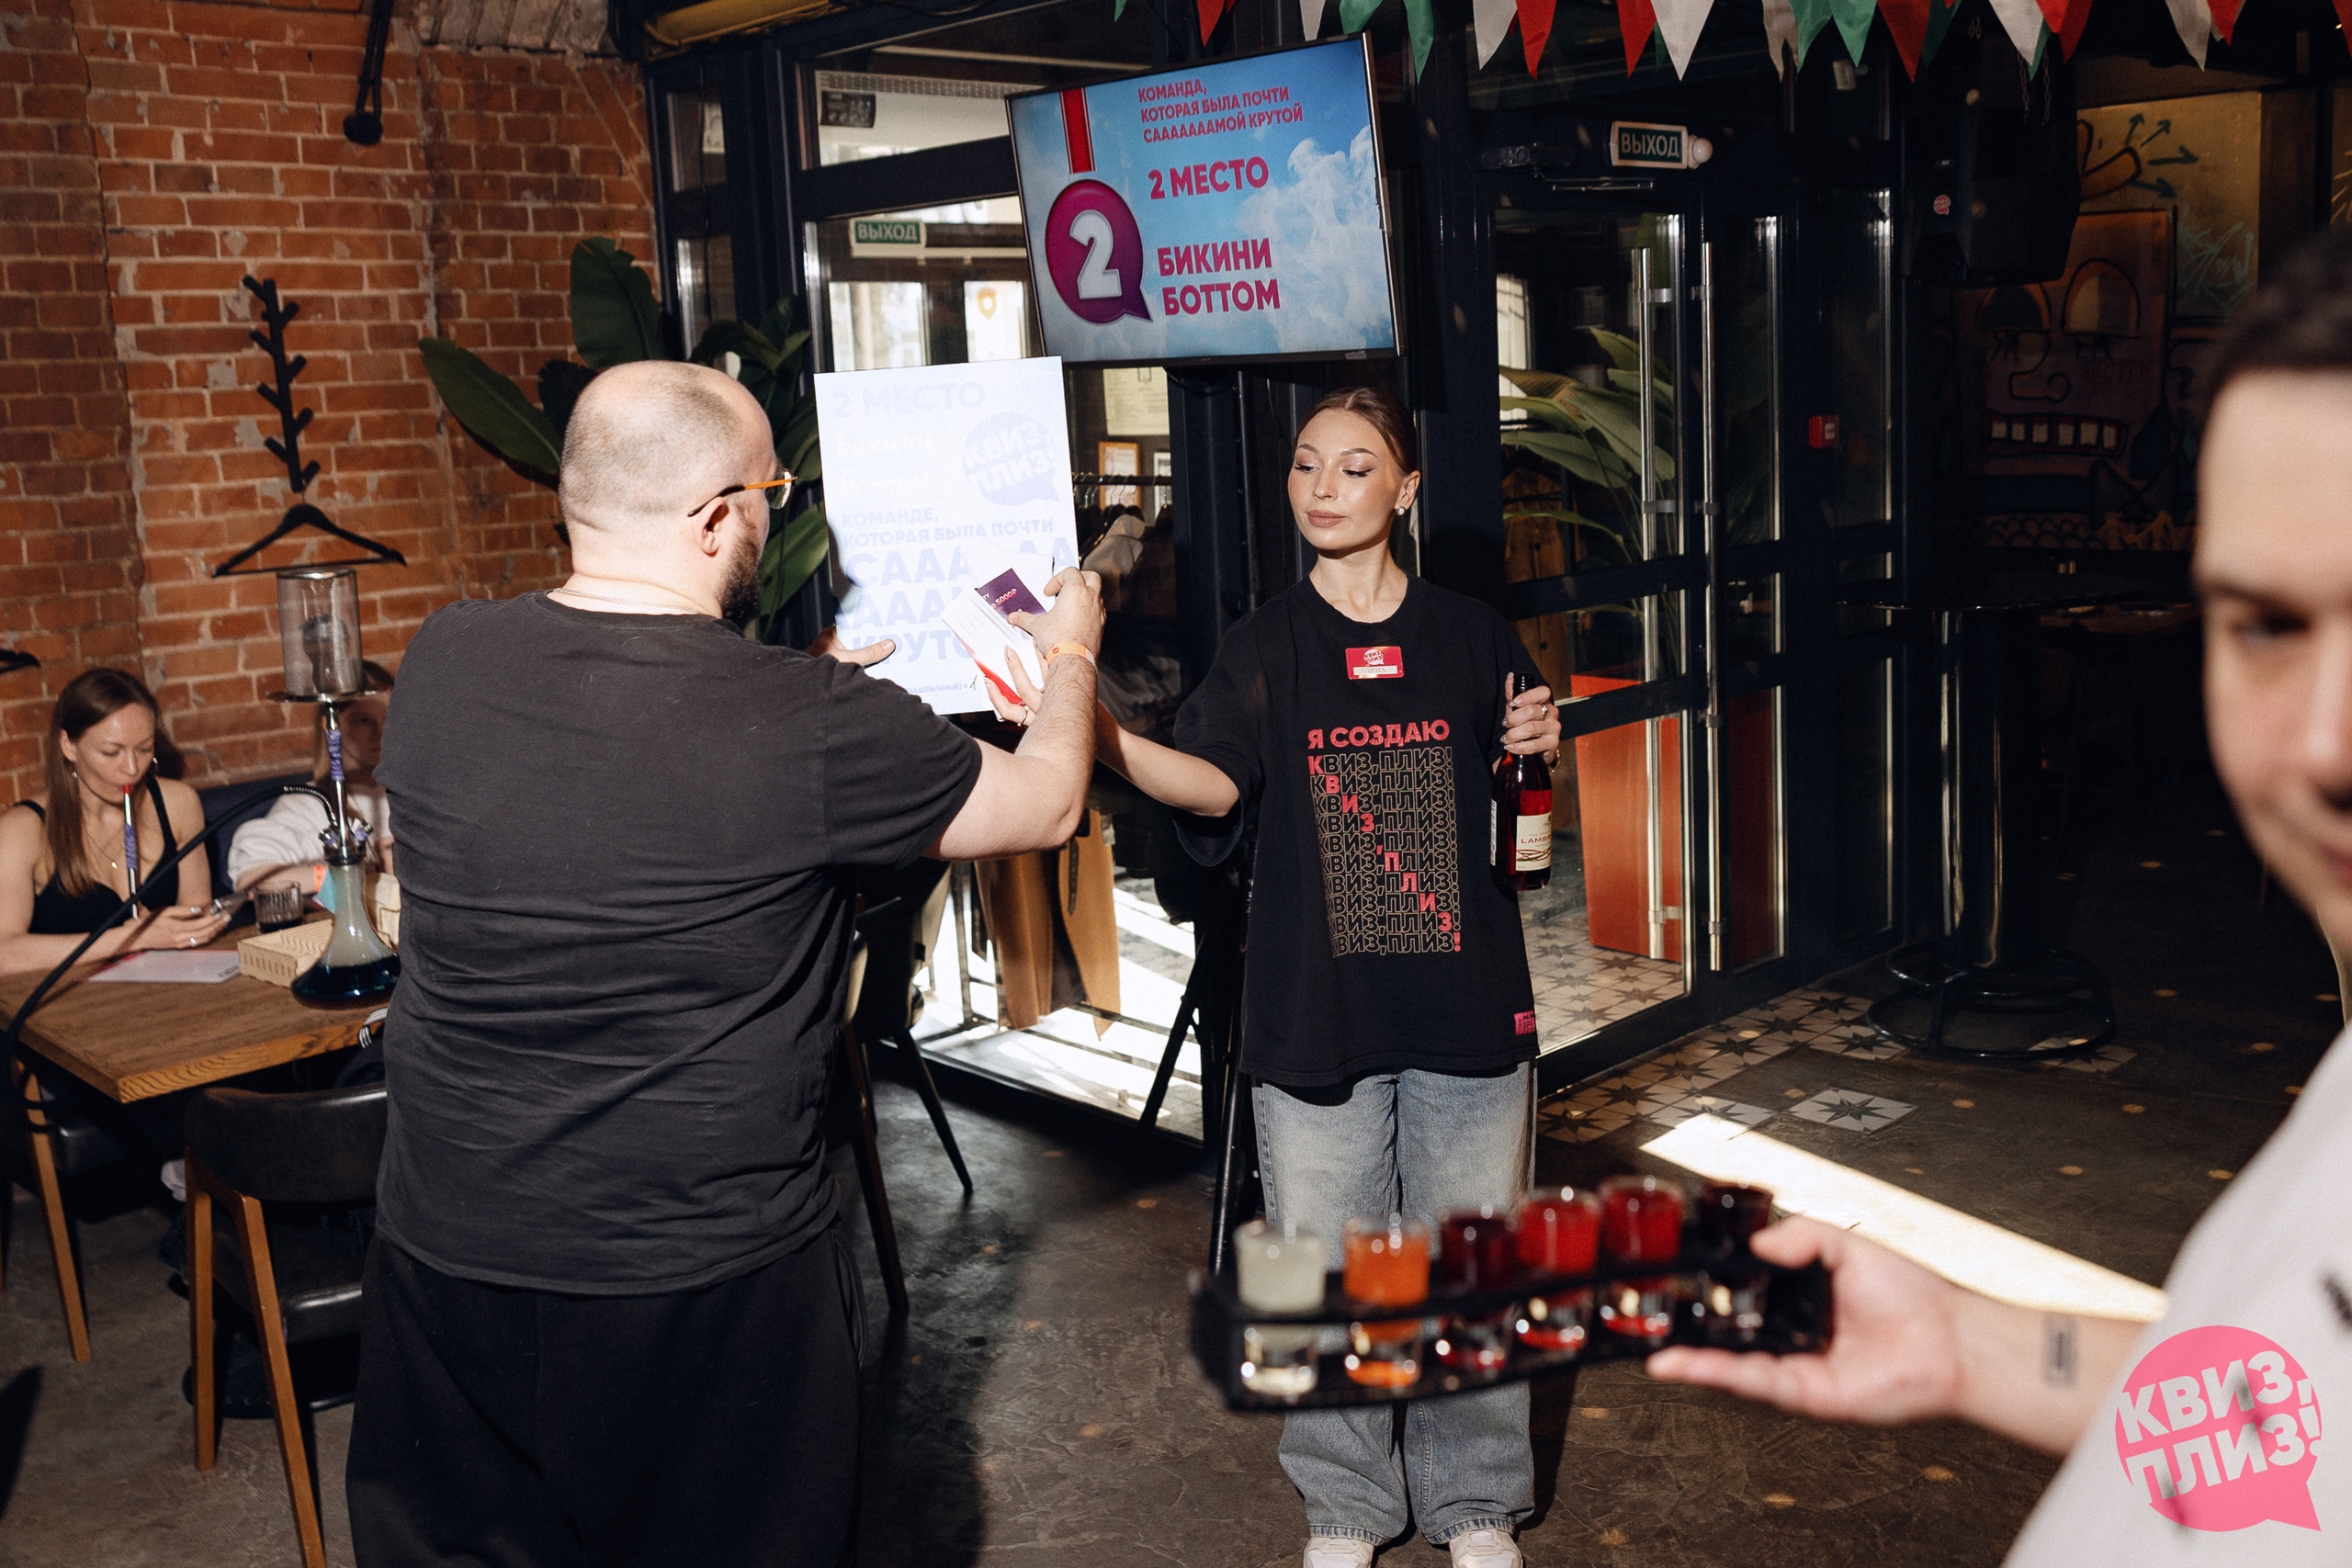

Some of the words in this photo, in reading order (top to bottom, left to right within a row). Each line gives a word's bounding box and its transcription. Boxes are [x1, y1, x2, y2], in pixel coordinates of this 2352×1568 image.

[1138, 79, 1207, 102] КОМАНДА,
[1141, 100, 1200, 123] КОТОРАЯ
[1202, 95, 1240, 113] БЫЛА
[1242, 85, 1290, 107] ПОЧТИ
[1249, 102, 1304, 129] КРУТОЙ
[1622, 133, 1679, 158] ВЫХОД
[1148, 169, 1165, 199] 2
[1171, 156, 1269, 197] МЕСТО
[858, 223, 918, 241] ВЫХОД
[1069, 209, 1122, 300] 2
[1158, 238, 1272, 276] БИКИНИ
[1162, 279, 1281, 315] БОТТОМ
[831, 389, 852, 419] 2
[863, 381, 985, 415] МЕСТО
[842, 507, 939, 527] КОМАНДЕ,
[842, 529, 930, 548] КОТОРАЯ
[934, 525, 987, 541] БЫЛА
[992, 518, 1053, 536] ПОЧТИ
[1308, 729, 1324, 749] Я
[1330, 719, 1450, 748] СОЗДАЮ
